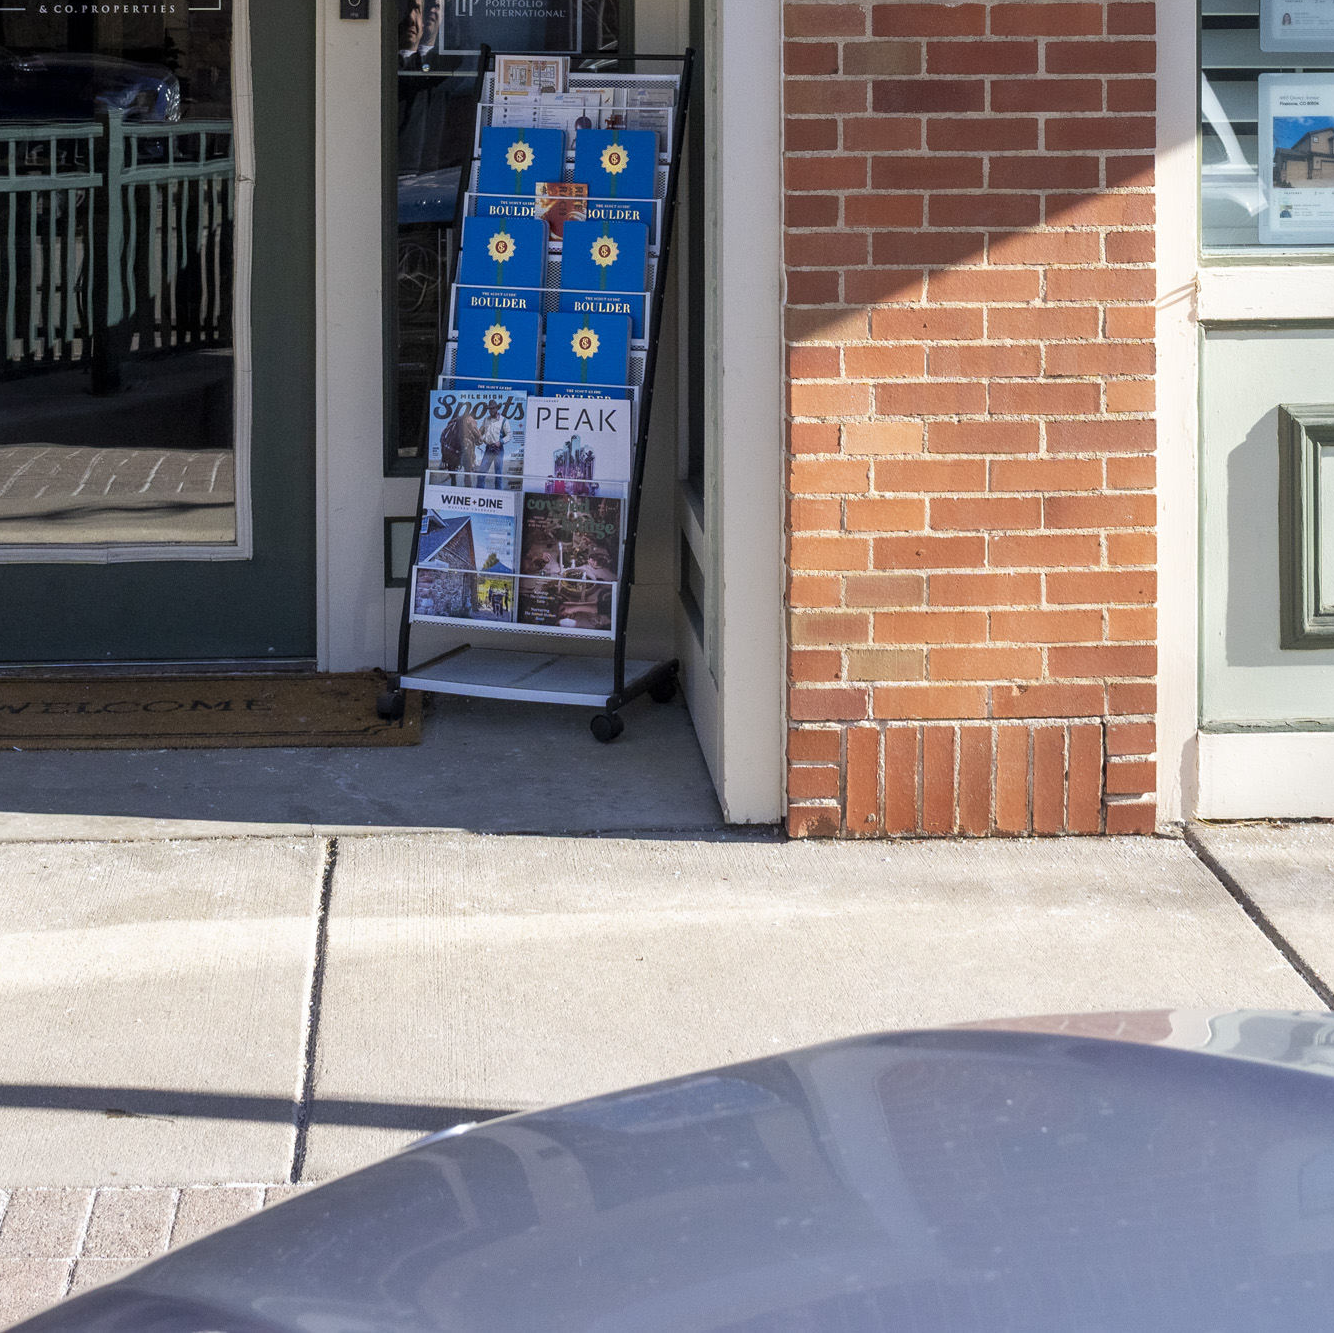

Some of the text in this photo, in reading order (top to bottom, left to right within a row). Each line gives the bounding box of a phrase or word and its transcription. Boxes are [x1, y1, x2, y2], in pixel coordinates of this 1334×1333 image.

[39, 5, 48, 13] &
[485, 0, 543, 8] PORTFOLIO
[471, 296, 527, 309] BOULDER
[574, 302, 631, 313] BOULDER
[433, 395, 525, 420] Sports
[537, 407, 617, 432] PEAK
[441, 495, 503, 509] WINE DINE
